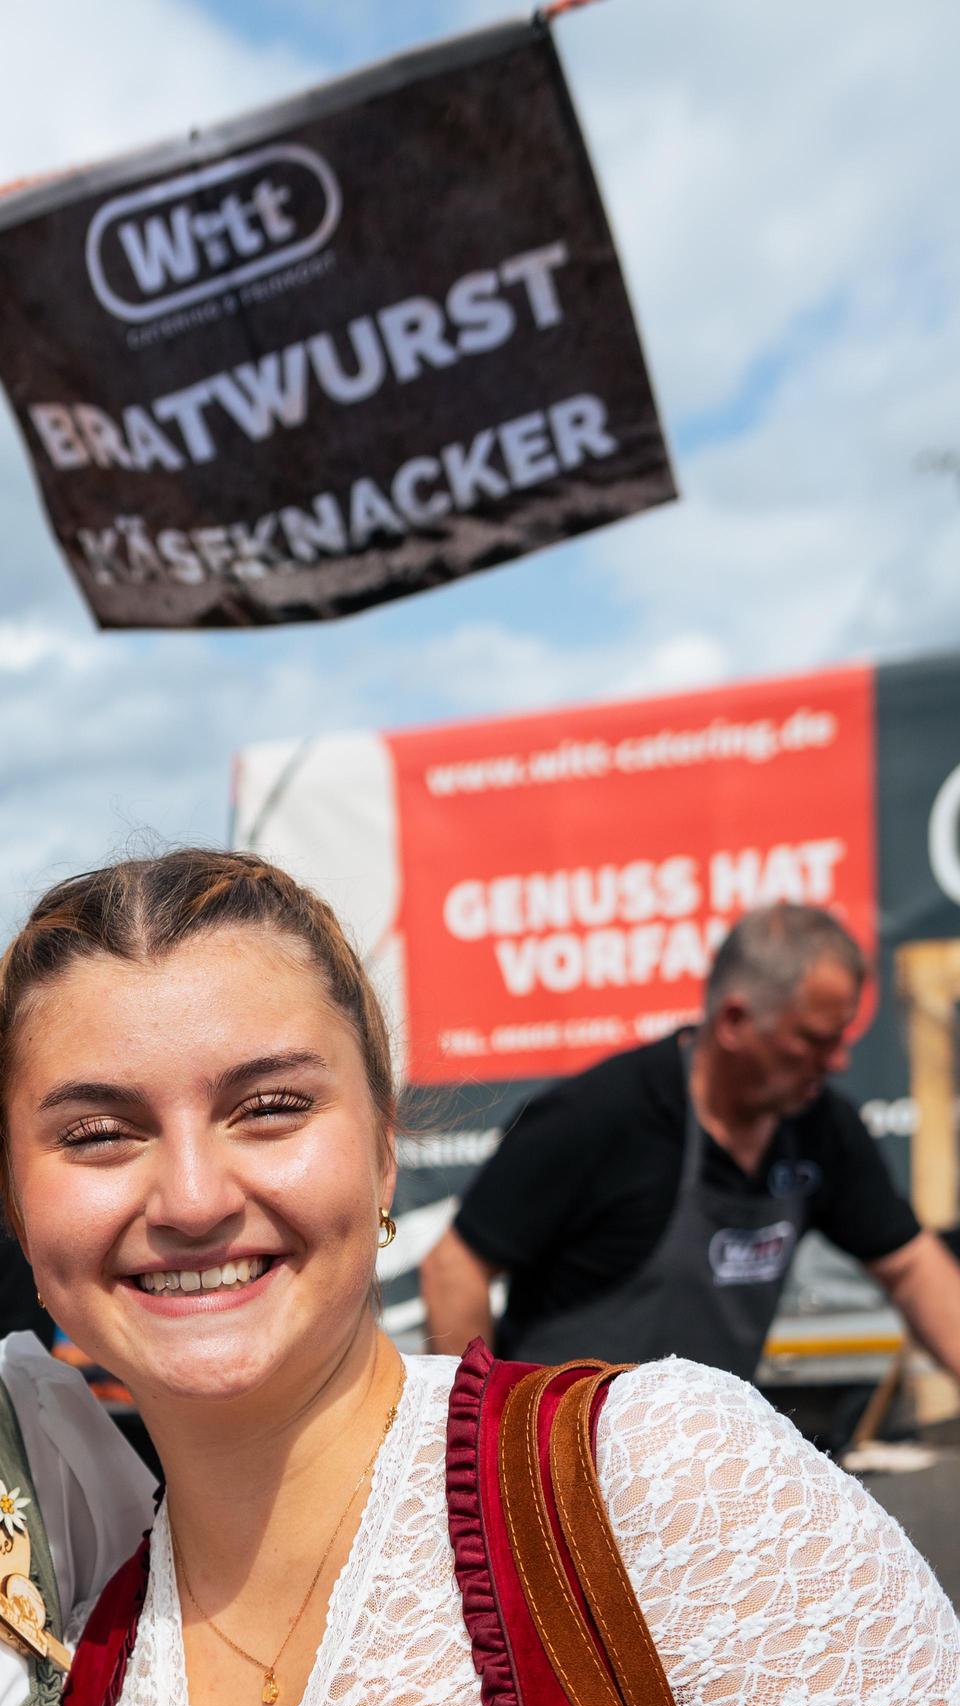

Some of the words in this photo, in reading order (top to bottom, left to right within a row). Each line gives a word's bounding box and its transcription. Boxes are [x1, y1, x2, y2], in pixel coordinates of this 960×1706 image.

[117, 179, 295, 294] Witt
[29, 240, 568, 472] BRATWURST
[79, 393, 616, 584] KÄSEKNACKER
[445, 858, 699, 940] GENUSS
[710, 838, 843, 910] HAT
